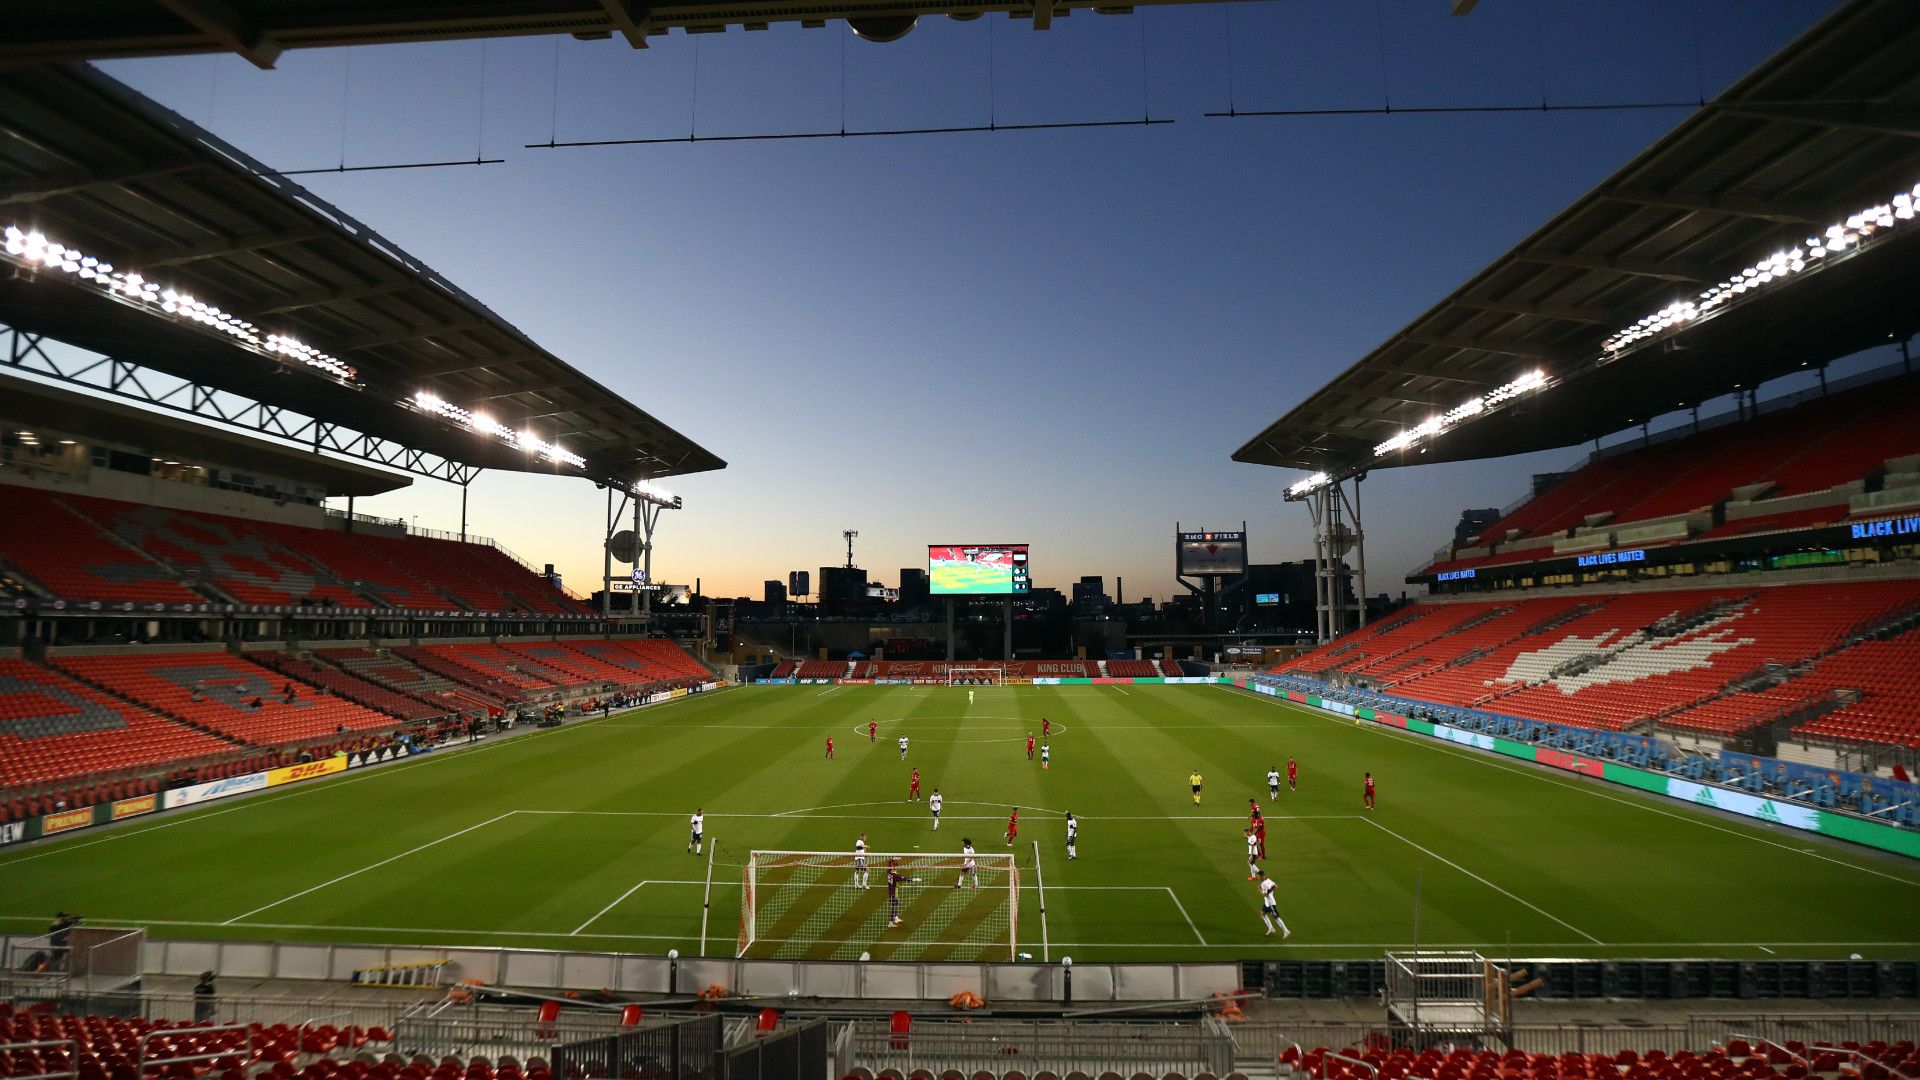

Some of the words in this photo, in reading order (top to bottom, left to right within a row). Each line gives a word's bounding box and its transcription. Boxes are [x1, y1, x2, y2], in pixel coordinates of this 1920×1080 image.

[1851, 521, 1894, 539] BLACK
[1578, 555, 1598, 567] BLACK
[1598, 553, 1617, 565] LIVES
[1617, 549, 1645, 562] MATTER
[1437, 572, 1449, 582] BLACK
[1449, 571, 1460, 580] LIVES
[1460, 569, 1475, 579] MATTER
[932, 664, 952, 673] KING
[1037, 664, 1059, 673] KING
[1060, 664, 1082, 673] CLUB
[289, 762, 328, 779] DHL
